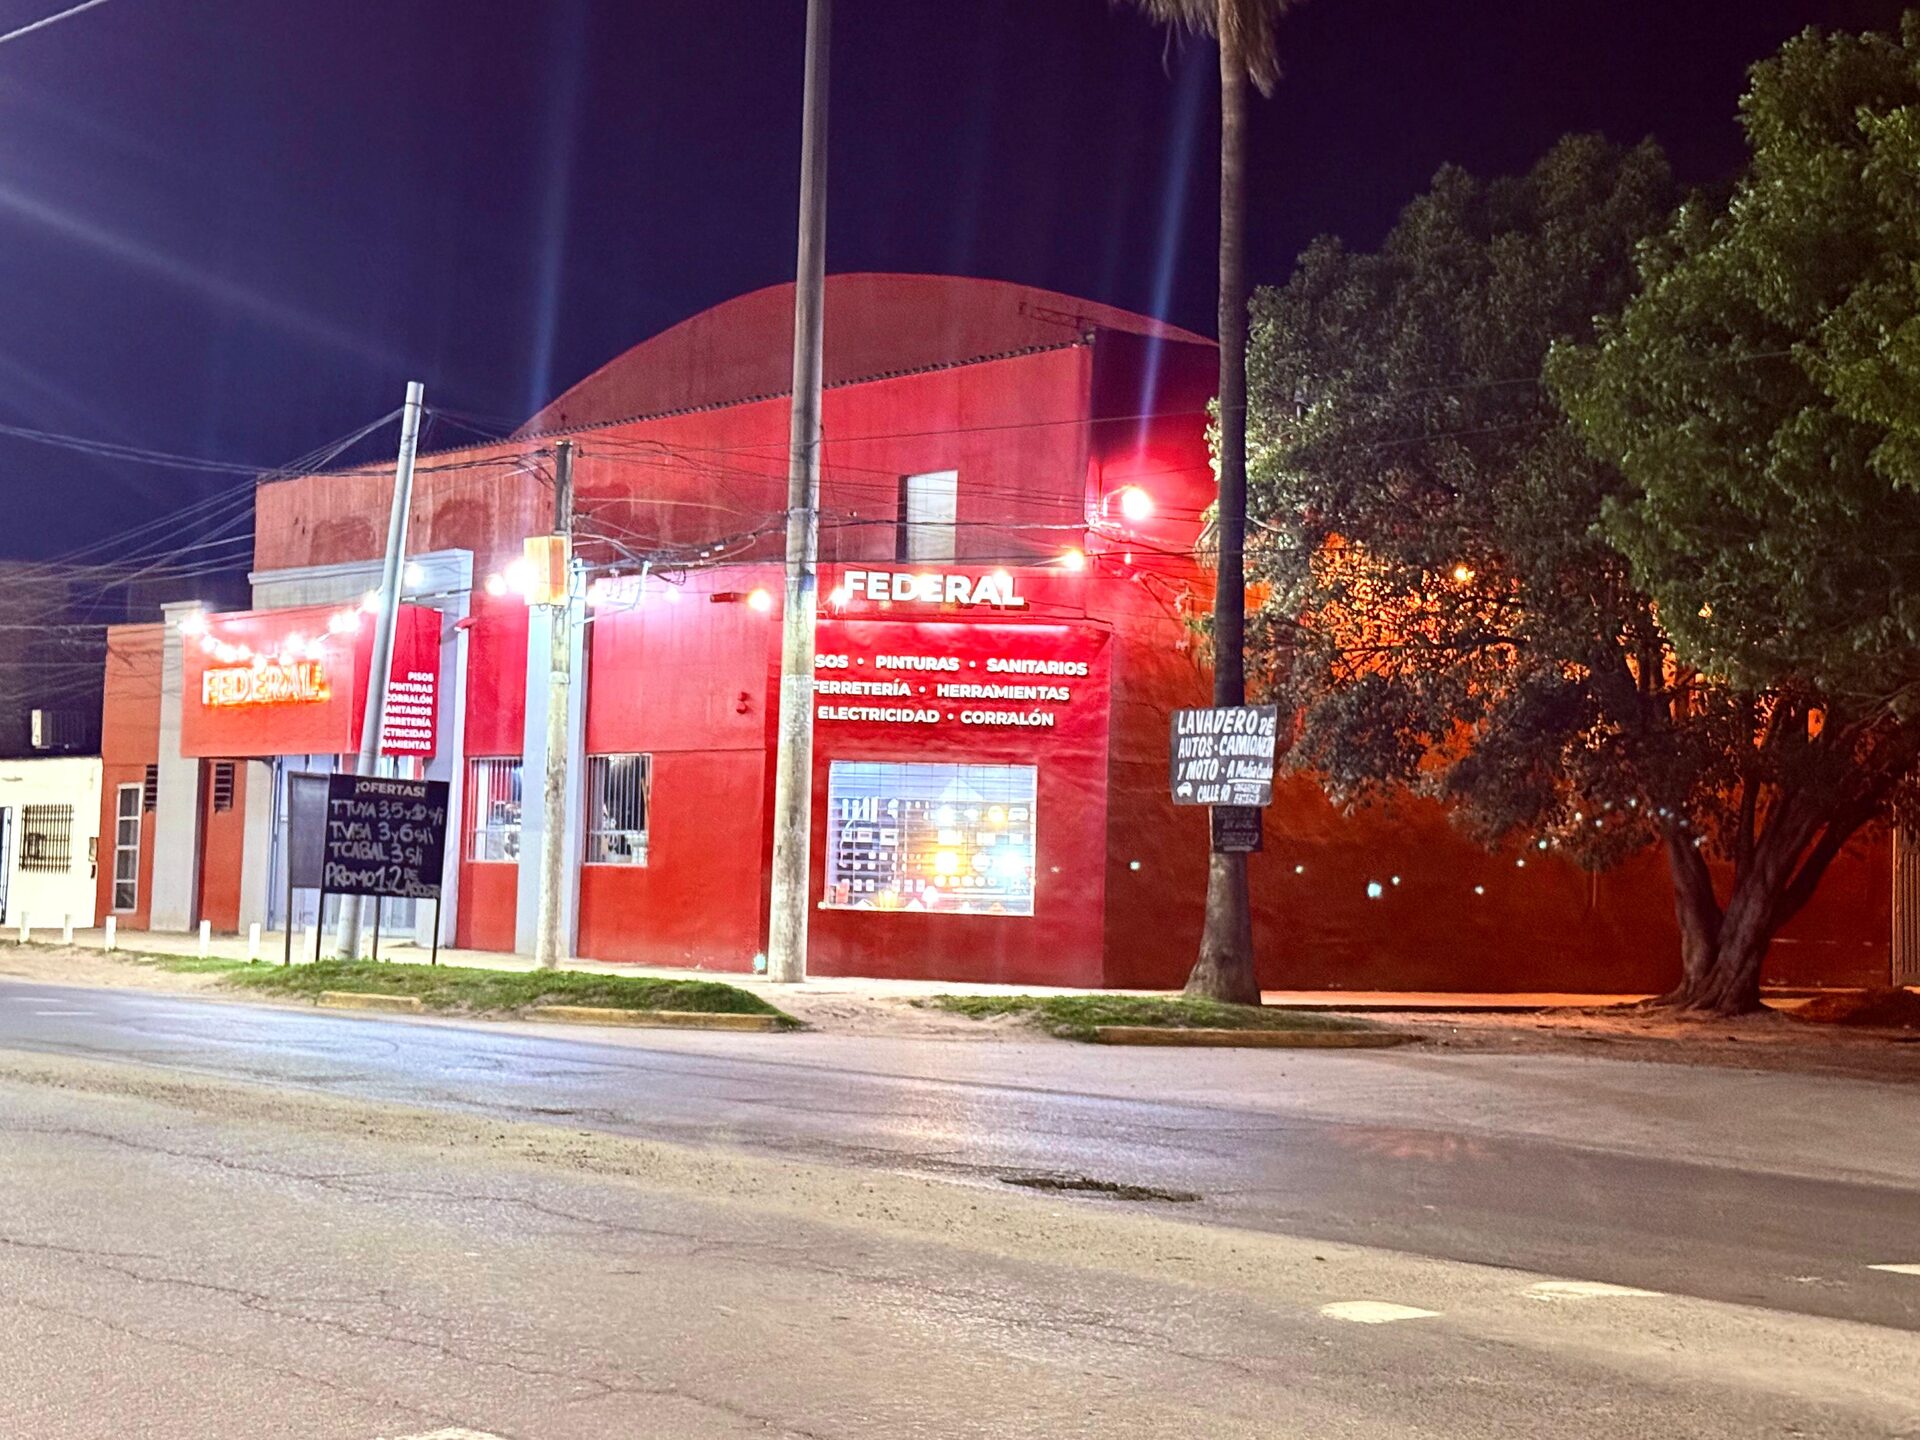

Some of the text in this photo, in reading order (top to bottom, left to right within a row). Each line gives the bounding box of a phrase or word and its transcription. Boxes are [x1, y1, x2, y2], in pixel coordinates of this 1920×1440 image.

[844, 570, 1024, 606] FEDERAL
[814, 654, 1088, 676] SOS PINTURAS SANITARIOS
[202, 663, 322, 705] FEDERAL
[407, 672, 434, 682] PISOS
[389, 682, 433, 693] PINTURAS
[936, 683, 1070, 701] HERRAMIENTAS
[385, 704, 432, 716] ANITARIOS
[817, 705, 1054, 726] ELECTRICIDAD CORRALÓN
[384, 715, 432, 727] ERRETERÍA
[1177, 709, 1275, 736] LAVADERO DE
[384, 727, 432, 739] CTRICIDAD
[380, 738, 431, 750] RAMIENTAS
[1177, 736, 1213, 758] AUTOS
[1186, 758, 1219, 780] MOTO
[1226, 760, 1236, 778] A
[1197, 784, 1220, 803] CALLE
